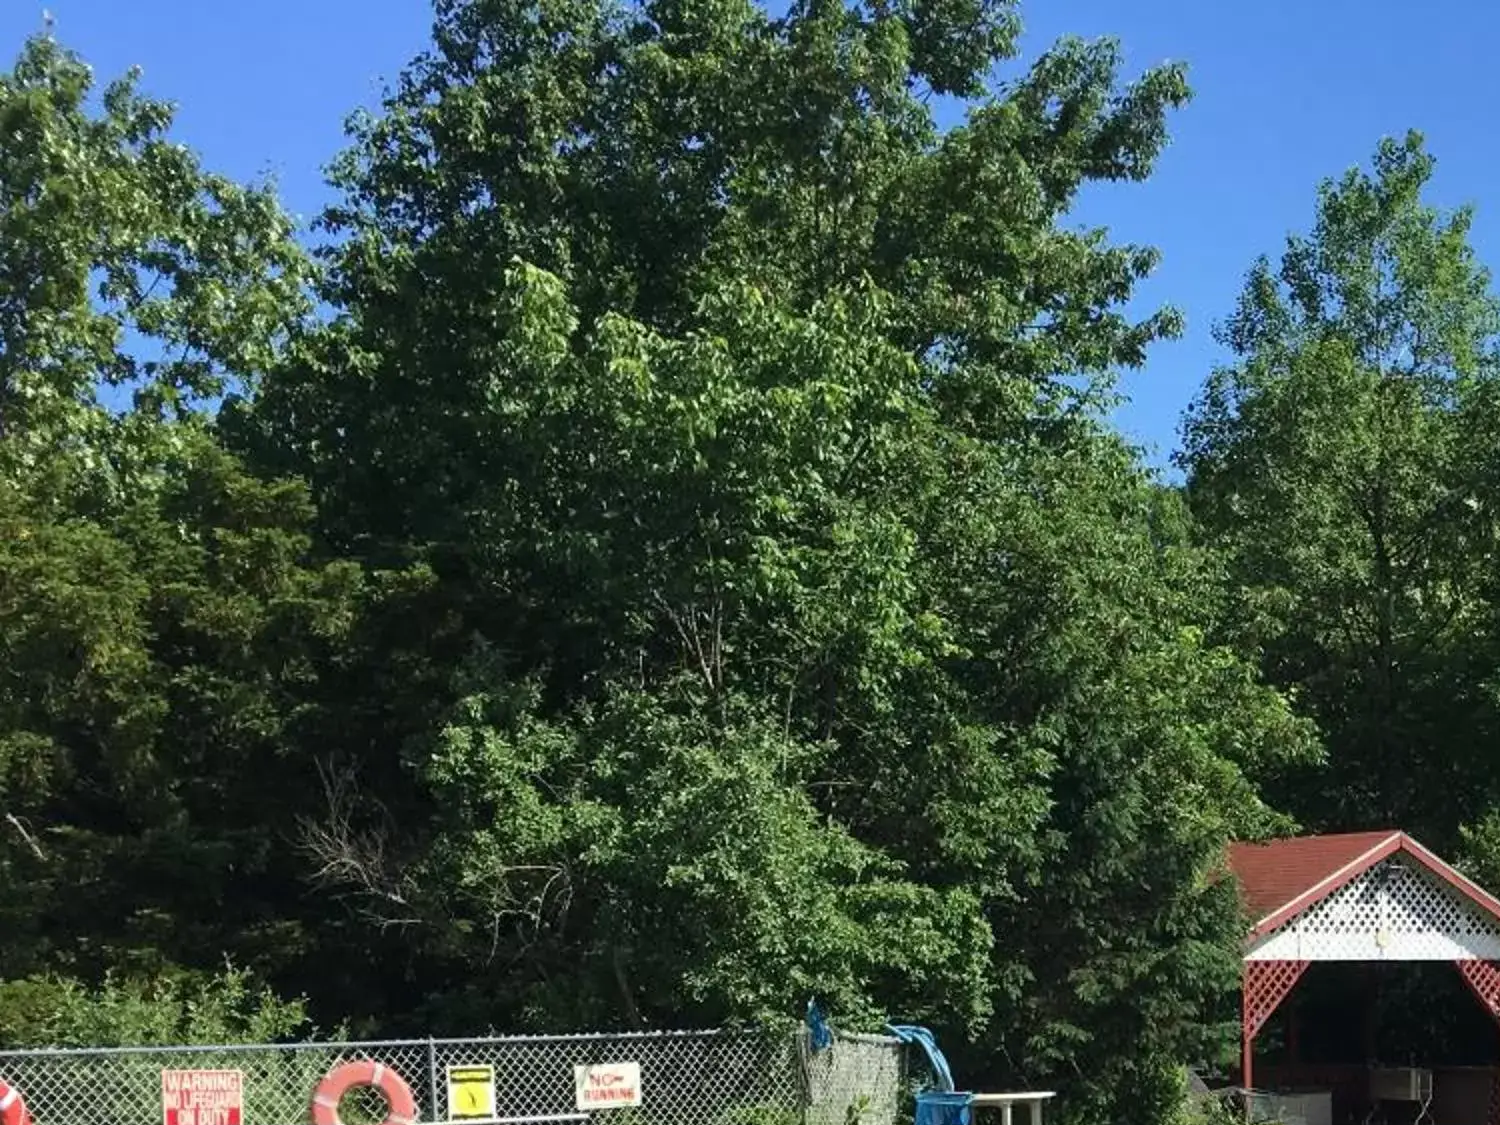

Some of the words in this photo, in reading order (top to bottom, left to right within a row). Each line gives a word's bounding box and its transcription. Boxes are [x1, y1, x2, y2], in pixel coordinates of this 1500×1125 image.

[166, 1072, 239, 1091] WARNING
[165, 1091, 181, 1109] NO
[183, 1090, 240, 1109] LIFEGUARD
[584, 1088, 636, 1101] RUNNING
